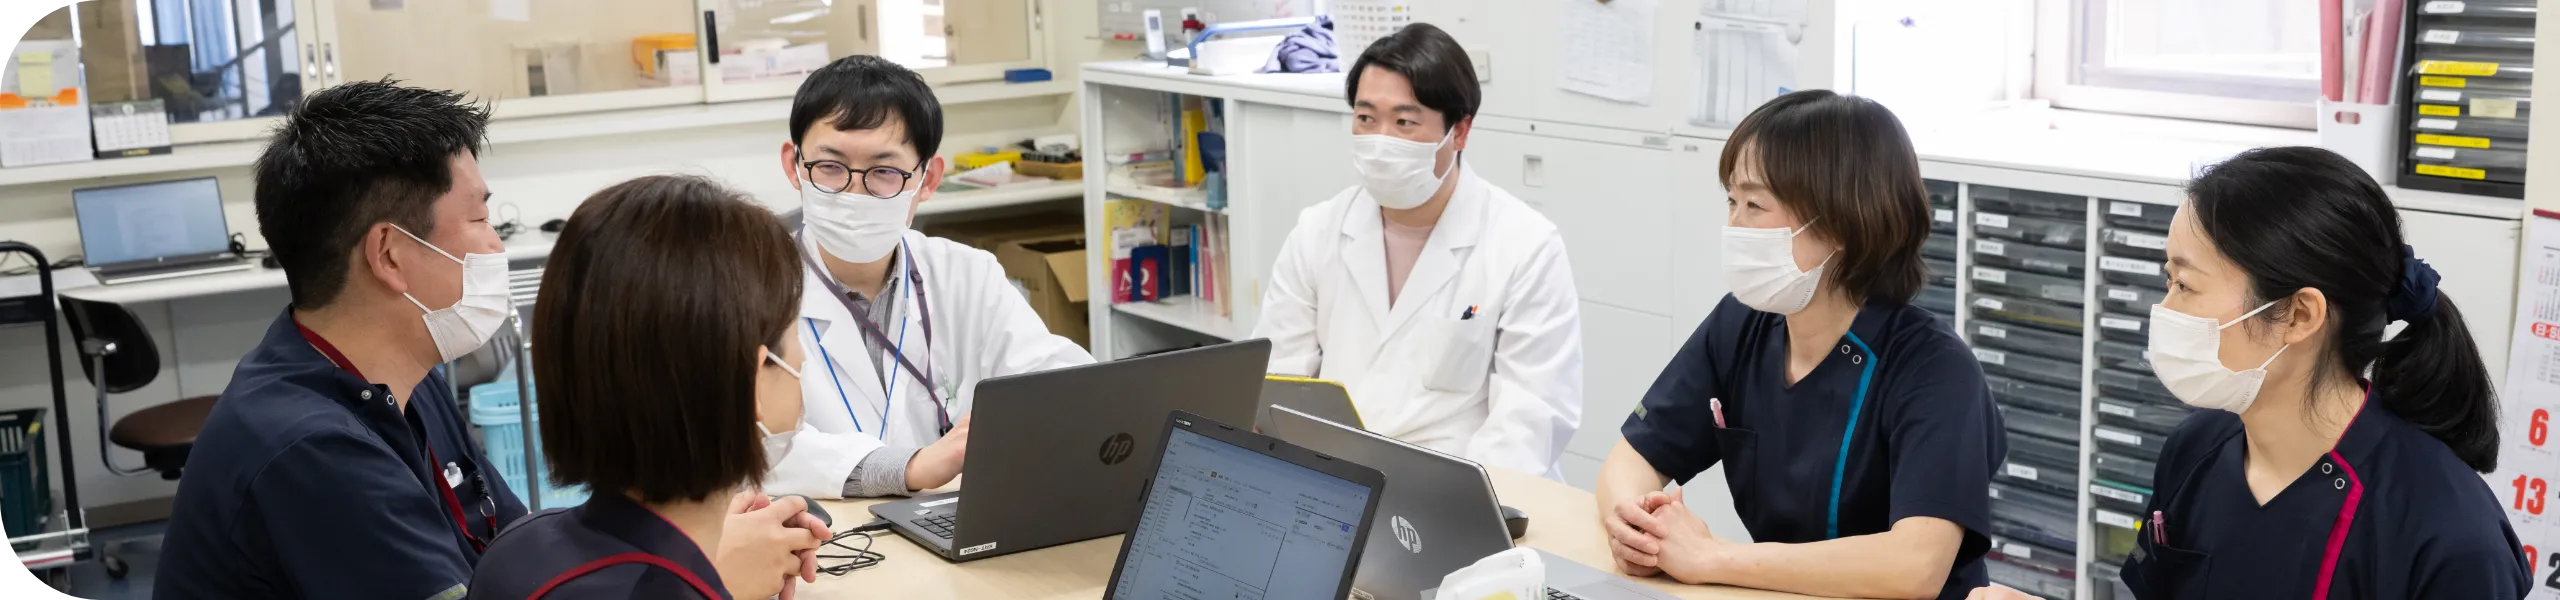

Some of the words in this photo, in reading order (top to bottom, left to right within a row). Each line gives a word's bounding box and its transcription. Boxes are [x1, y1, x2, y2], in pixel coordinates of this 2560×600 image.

[2528, 408, 2549, 447] 6
[1100, 433, 1133, 466] hp
[2512, 474, 2547, 515] 13
[1391, 515, 1421, 553] hp
